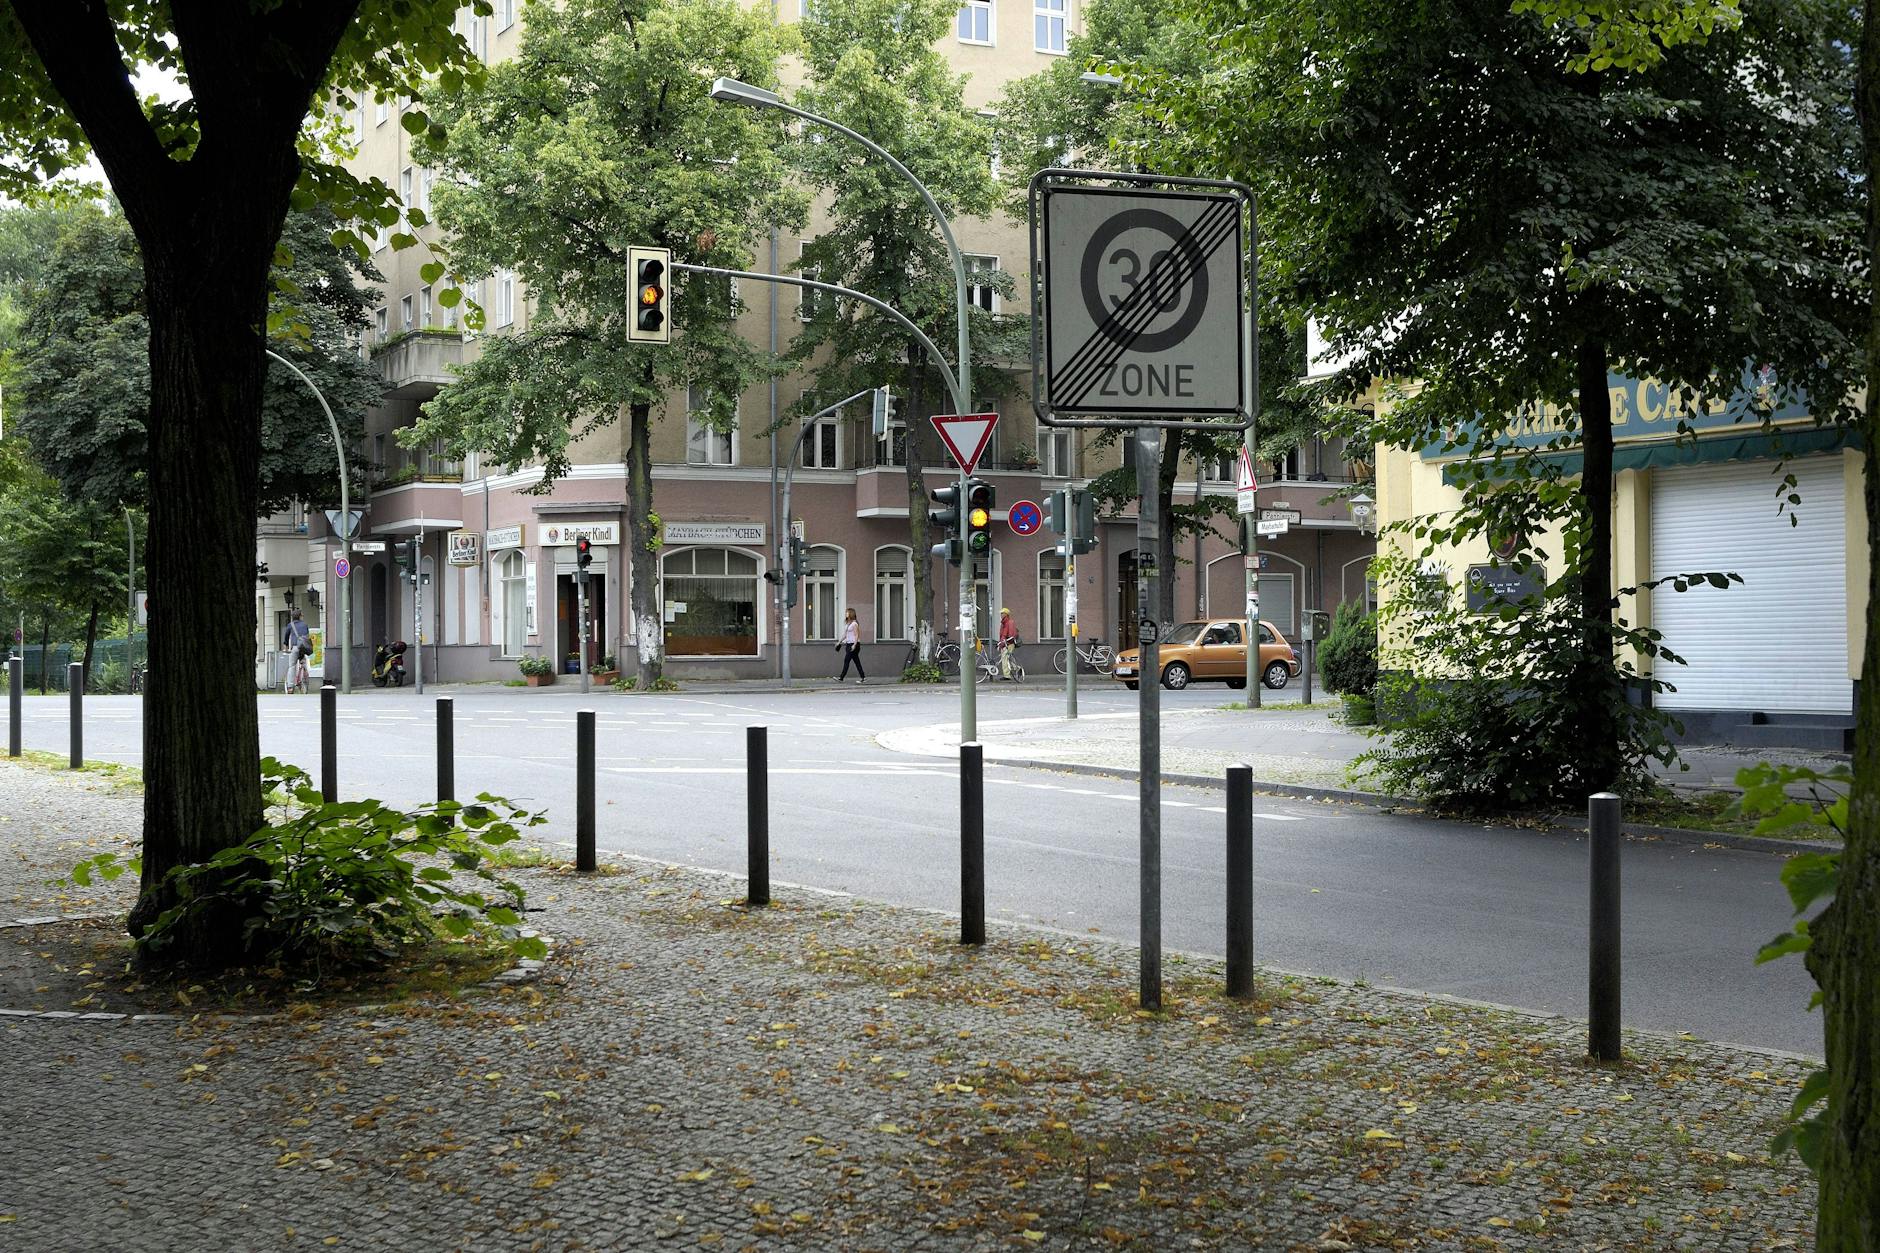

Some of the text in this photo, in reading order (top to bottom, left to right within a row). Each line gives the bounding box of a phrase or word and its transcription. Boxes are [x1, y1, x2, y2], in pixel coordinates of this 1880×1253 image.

[1108, 248, 1182, 313] 30
[1099, 363, 1195, 398] ZONE
[592, 526, 612, 541] Kindl
